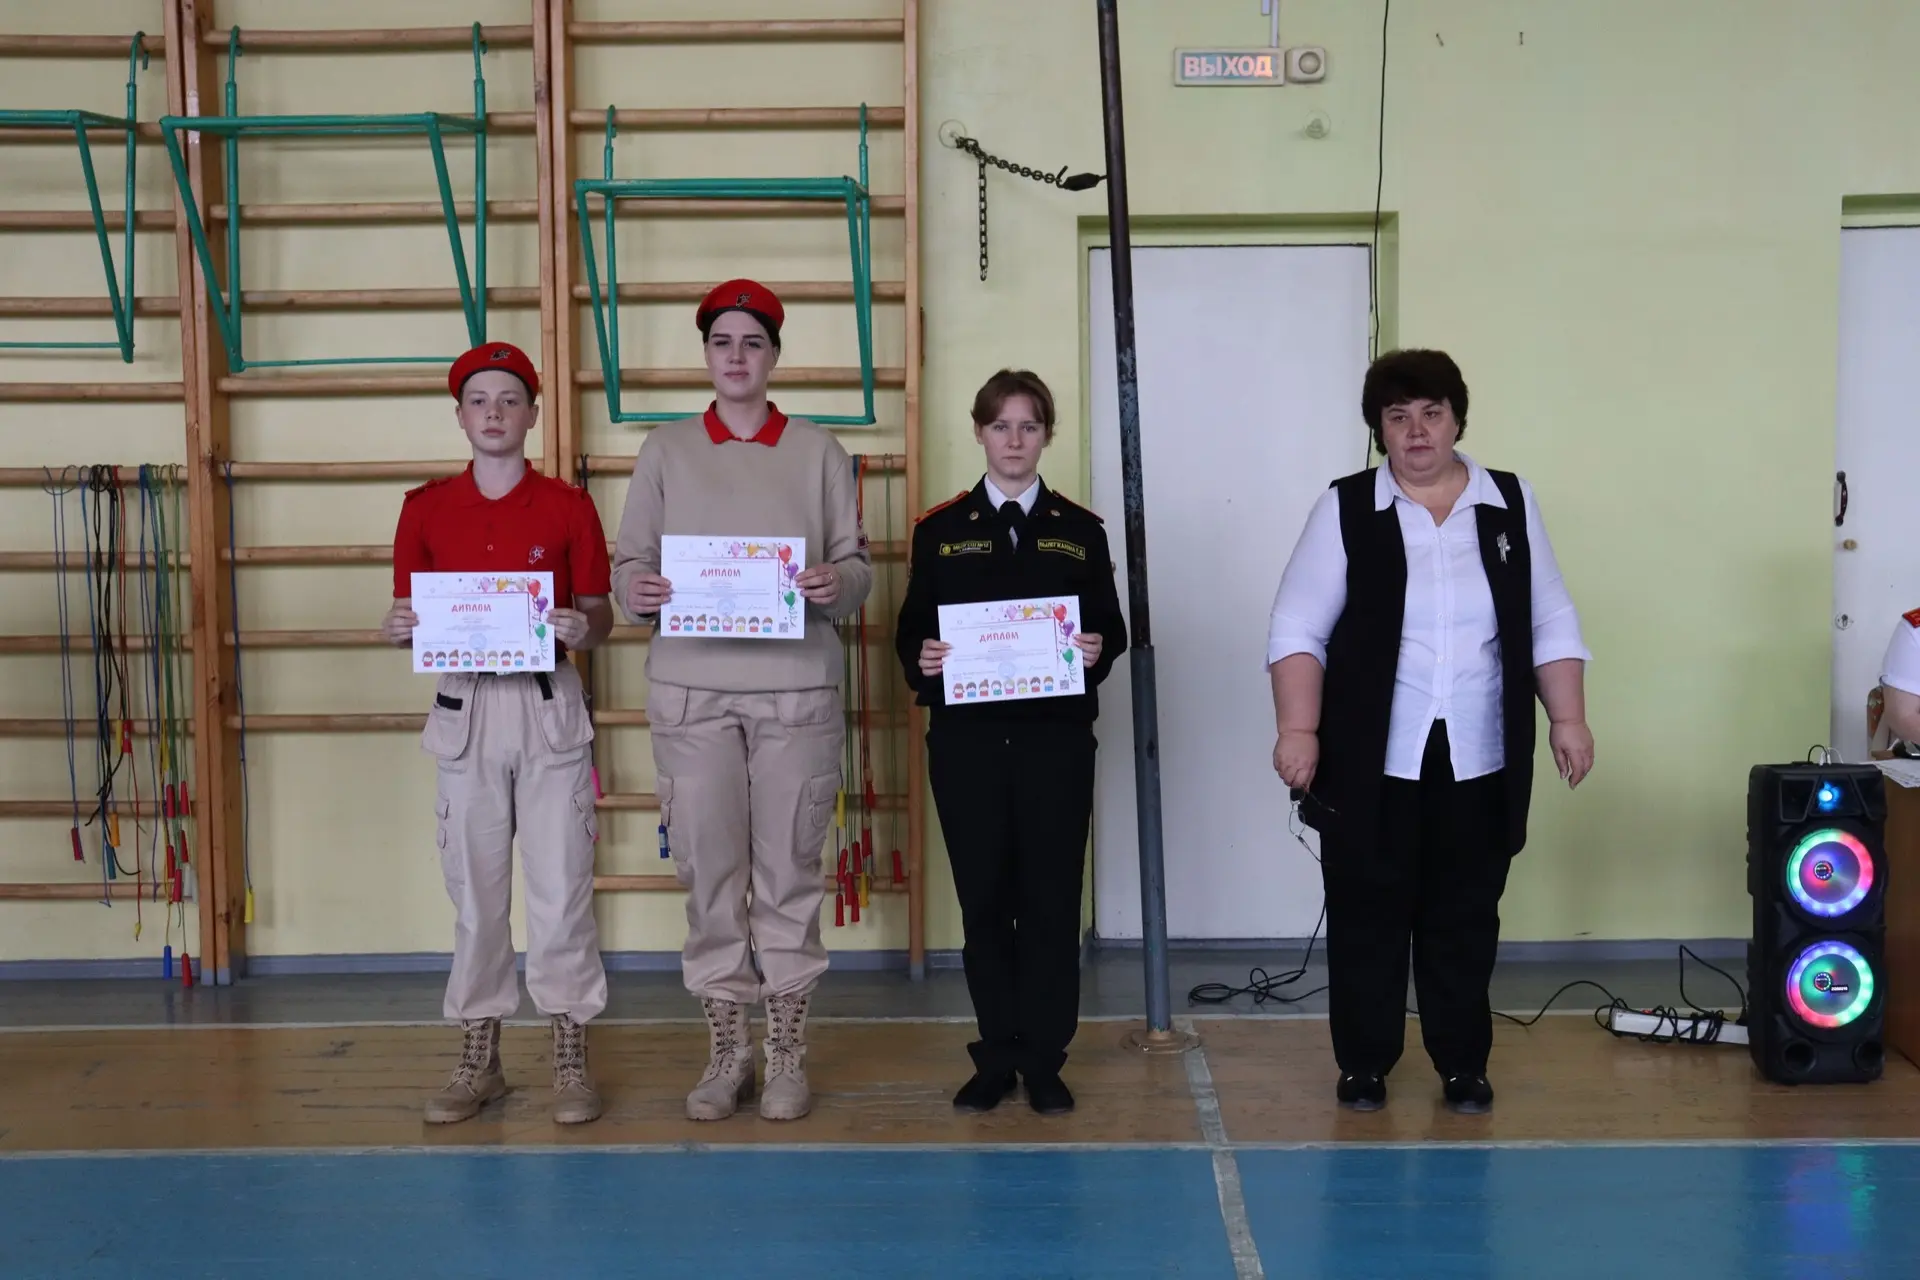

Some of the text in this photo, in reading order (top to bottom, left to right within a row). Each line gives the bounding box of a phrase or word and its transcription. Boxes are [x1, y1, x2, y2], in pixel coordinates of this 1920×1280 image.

[1184, 56, 1273, 77] ВЫХОД
[700, 568, 741, 578] ДИПЛОМ
[451, 604, 492, 613] ДИПЛОМ
[979, 631, 1019, 643] ДИПЛОМ
